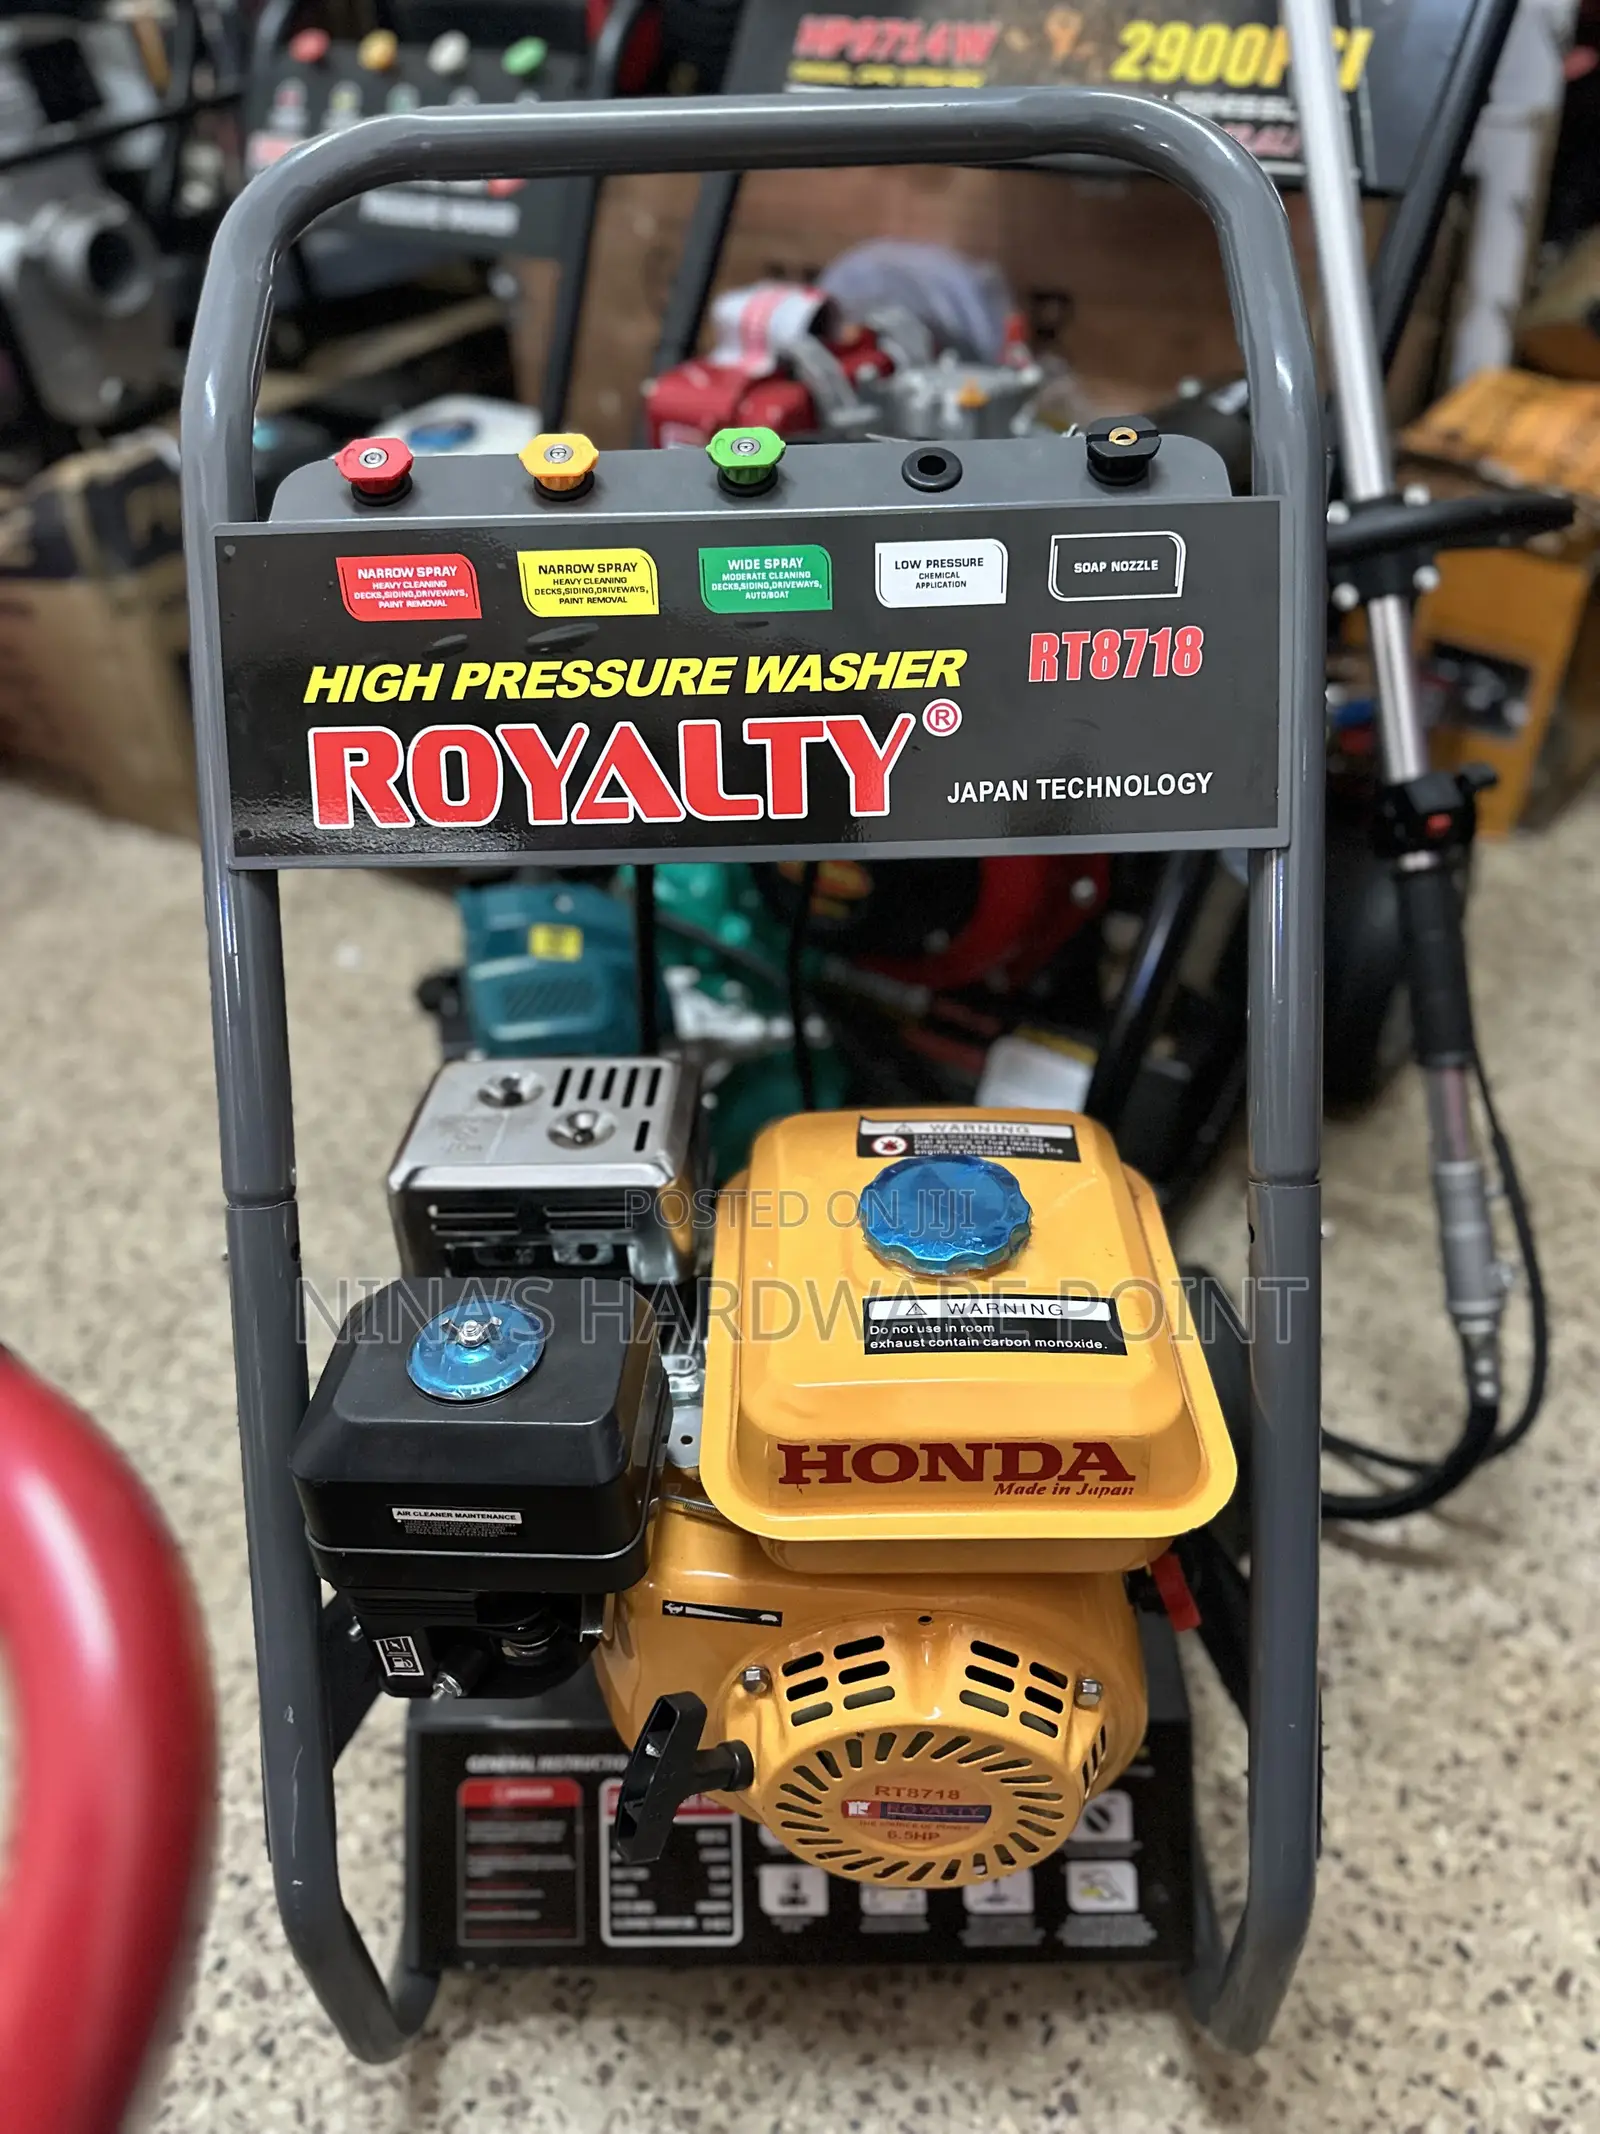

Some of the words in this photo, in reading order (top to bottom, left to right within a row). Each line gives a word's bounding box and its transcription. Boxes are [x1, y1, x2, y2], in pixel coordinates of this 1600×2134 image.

[538, 563, 595, 575] NARROW
[597, 562, 638, 573] SPRAY
[727, 559, 760, 570] WIDE
[764, 557, 804, 569] SPRAY
[895, 560, 921, 570] LOW
[926, 557, 984, 569] PRESSURE
[1073, 561, 1107, 574] SOAP
[1111, 560, 1159, 572] NOZZLE
[357, 568, 414, 579] NARROW
[416, 566, 458, 578] SPRAY
[722, 572, 766, 581] MODERATE
[768, 570, 811, 579] CLEANING
[918, 571, 960, 580] CHEMICAL
[372, 581, 401, 590] HEAVY
[403, 580, 447, 589] CLEANING
[553, 578, 582, 586] HEAVY
[584, 577, 627, 585] CLEANING
[915, 580, 967, 590] APPLICATION
[559, 597, 584, 605] PAINT
[587, 596, 628, 604] REMOVAL
[745, 591, 789, 600] AUTO/BOAT
[378, 601, 404, 609] PAINT
[406, 599, 448, 608] REMOVAL
[1028, 626, 1204, 683] RT8718
[303, 663, 445, 703] HIGH
[451, 656, 737, 700] PRESSURE
[743, 649, 967, 695] WASHER
[307, 715, 916, 829] ROYALTY
[947, 780, 1028, 804] JAPAN
[1036, 772, 1213, 800] TECHNOLOGY
[930, 1123, 1030, 1134] WARNING
[947, 1302, 1063, 1316] WARNING
[870, 1326, 888, 1335] Do
[892, 1325, 914, 1335] not
[917, 1325, 941, 1334] use
[945, 1323, 957, 1333] in
[960, 1324, 995, 1333] room
[870, 1338, 926, 1349] exhaust
[928, 1337, 983, 1347] contain
[985, 1337, 1031, 1347] carbon
[1034, 1338, 1108, 1349] monoxide.
[777, 1441, 1136, 1485] HONDA
[993, 1482, 1047, 1497] Made
[1052, 1483, 1071, 1496] in
[1075, 1482, 1135, 1499] Japan
[413, 1511, 453, 1519] CLEANER
[455, 1512, 517, 1520] MAINTENANCE
[874, 1785, 960, 1800] RT8718
[887, 1830, 940, 1840] 6.5HP
